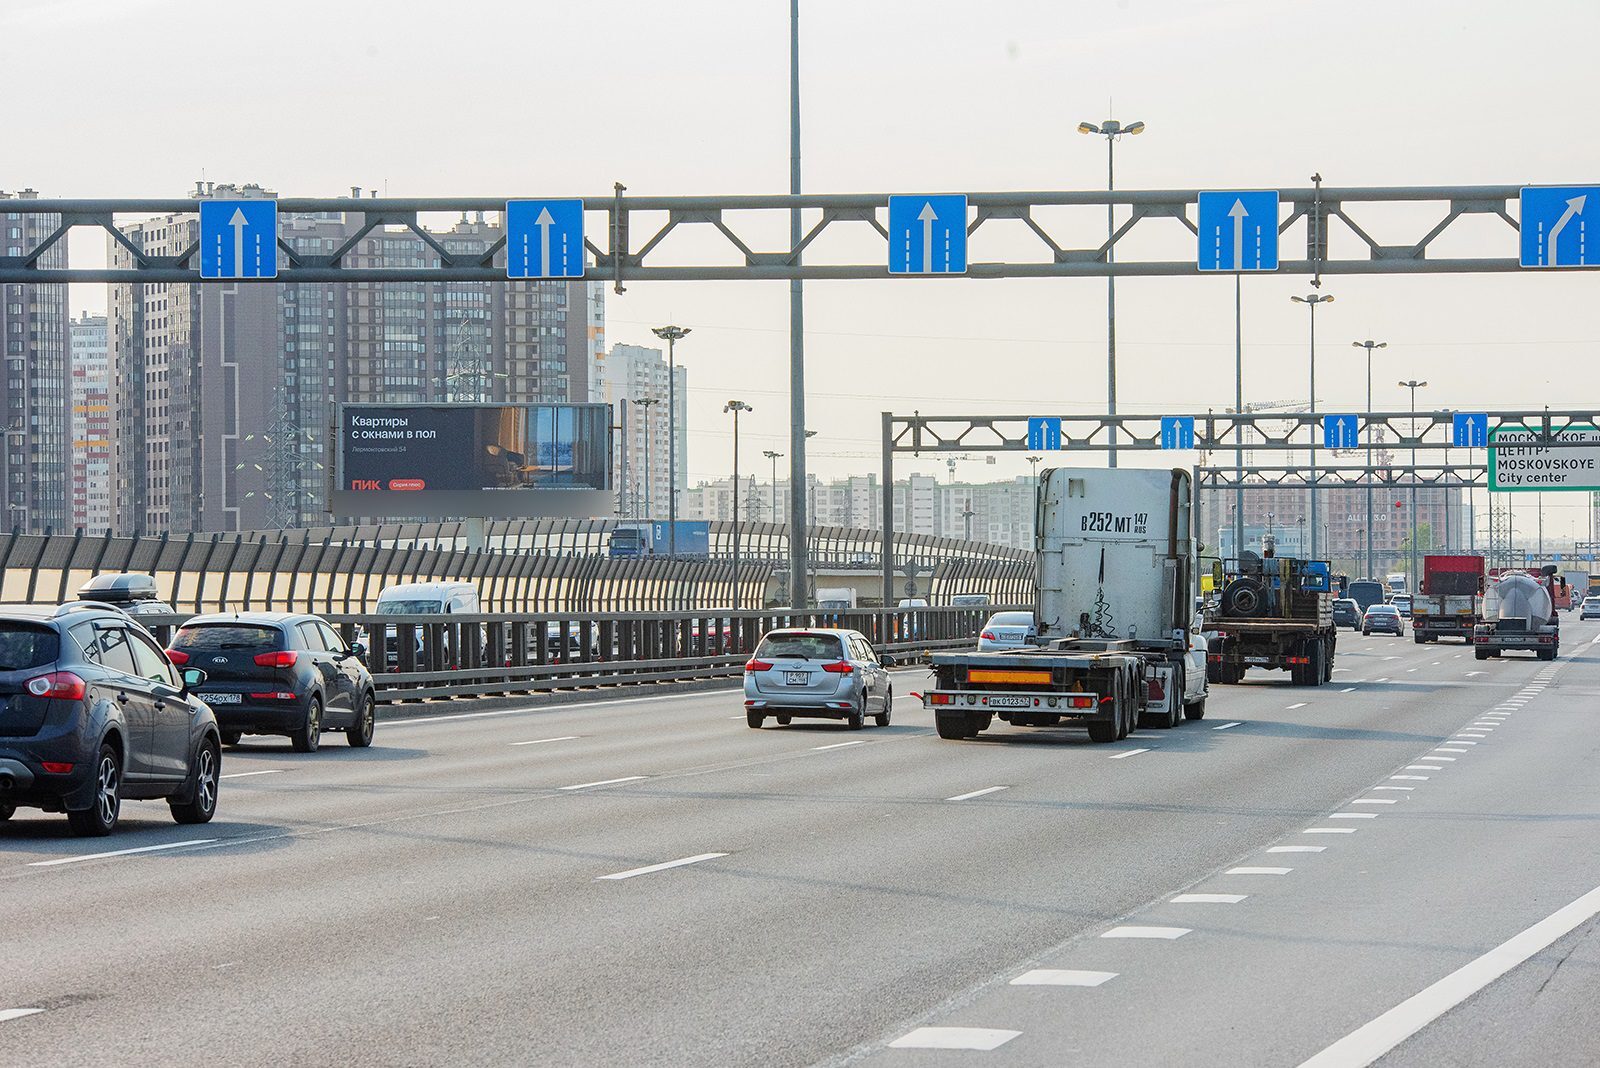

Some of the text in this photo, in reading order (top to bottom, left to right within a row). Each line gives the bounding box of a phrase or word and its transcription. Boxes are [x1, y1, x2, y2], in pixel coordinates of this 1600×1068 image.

[352, 415, 409, 428] Квартиры
[351, 430, 436, 439] с окнами в пол
[1498, 447, 1543, 457] ЦЕНТР
[1498, 459, 1594, 470] MOSKOVSKOYE
[1498, 473, 1568, 485] City center
[352, 480, 381, 490] ПИК
[1134, 513, 1148, 525] 147
[1134, 525, 1147, 534] RUS
